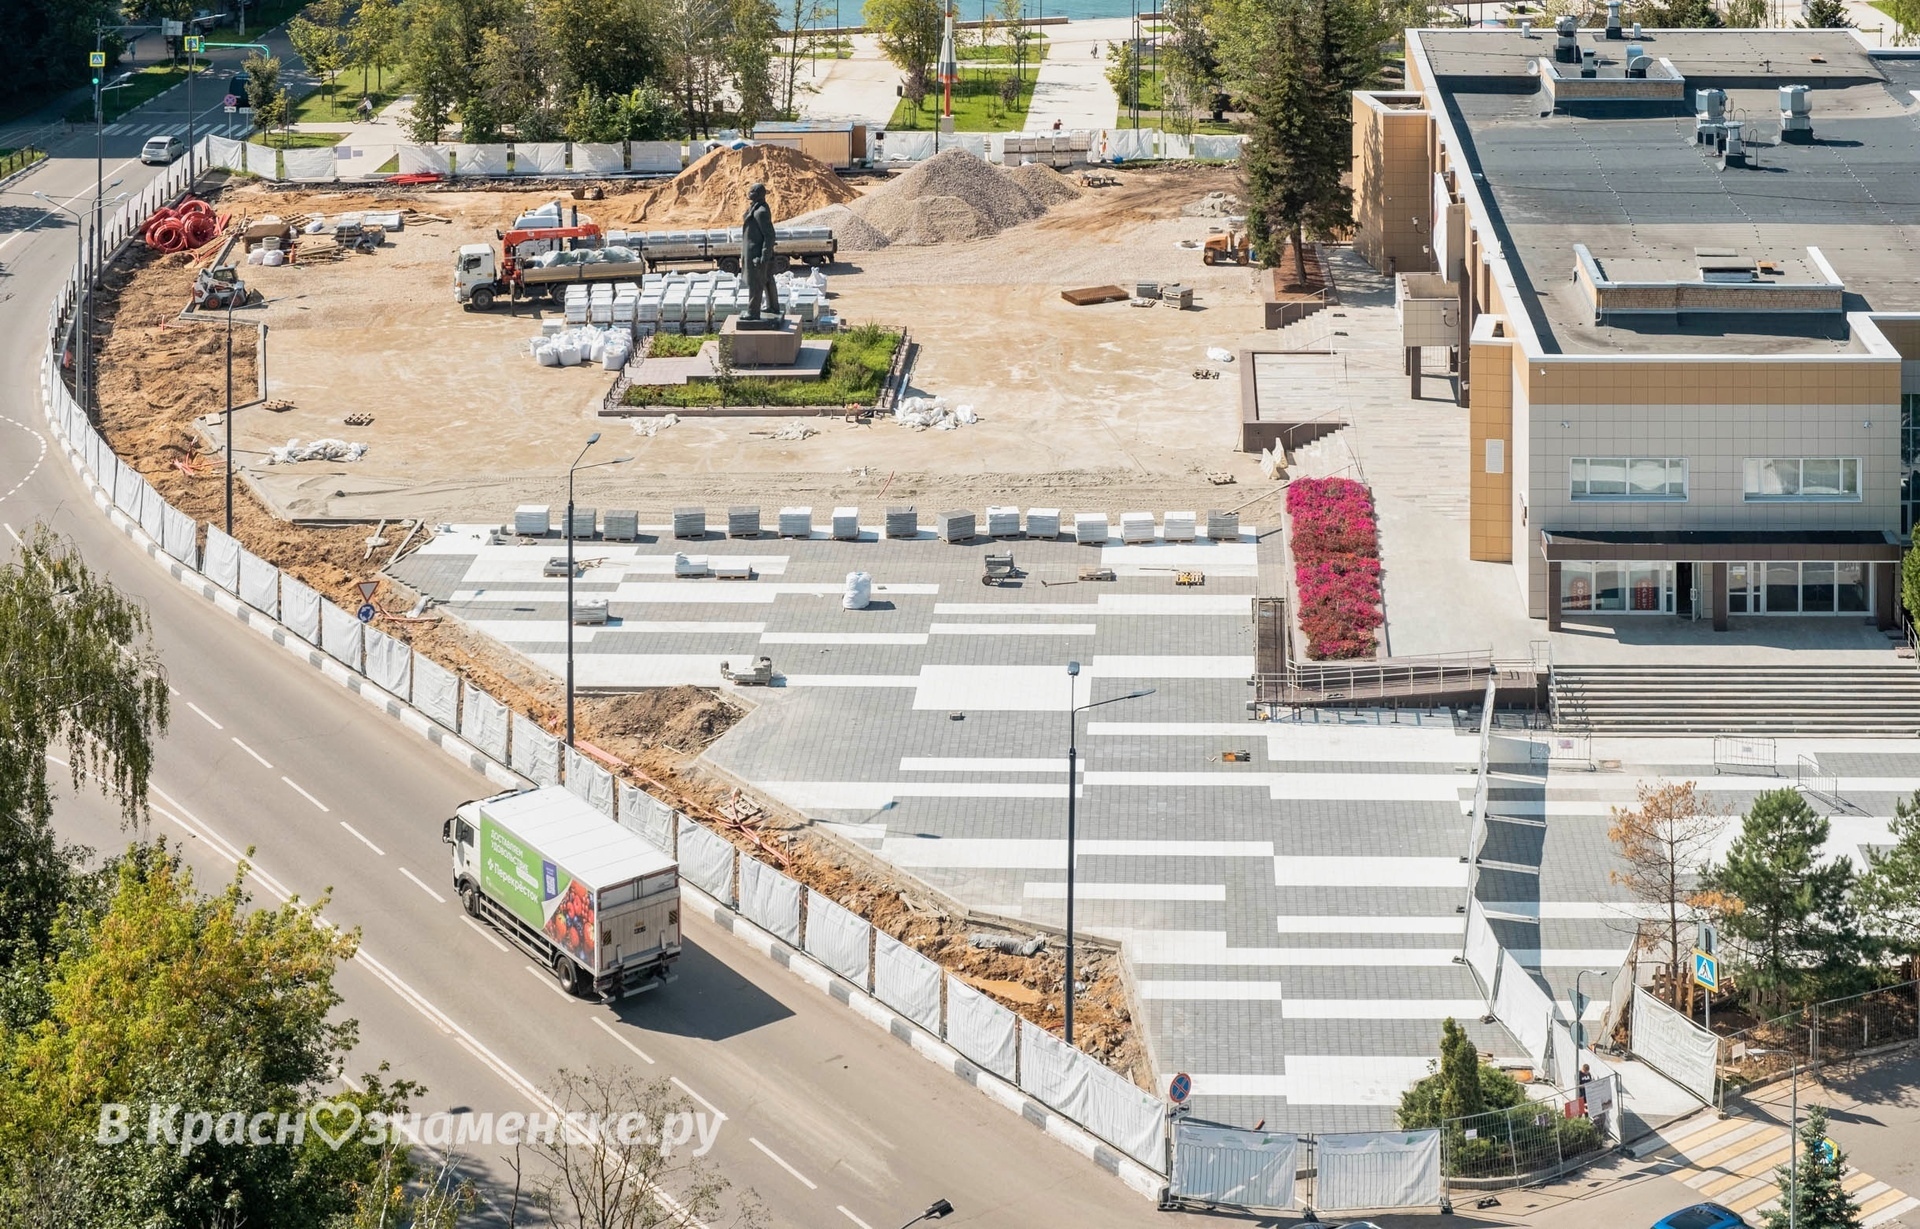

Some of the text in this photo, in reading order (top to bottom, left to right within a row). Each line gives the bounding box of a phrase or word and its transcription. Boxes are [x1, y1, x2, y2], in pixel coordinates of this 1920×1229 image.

[490, 829, 523, 858] ДОСТАВЛЯЕМ
[491, 840, 529, 874] УДОВОЛЬСТВИЕ
[495, 862, 539, 904] Перекрёсток
